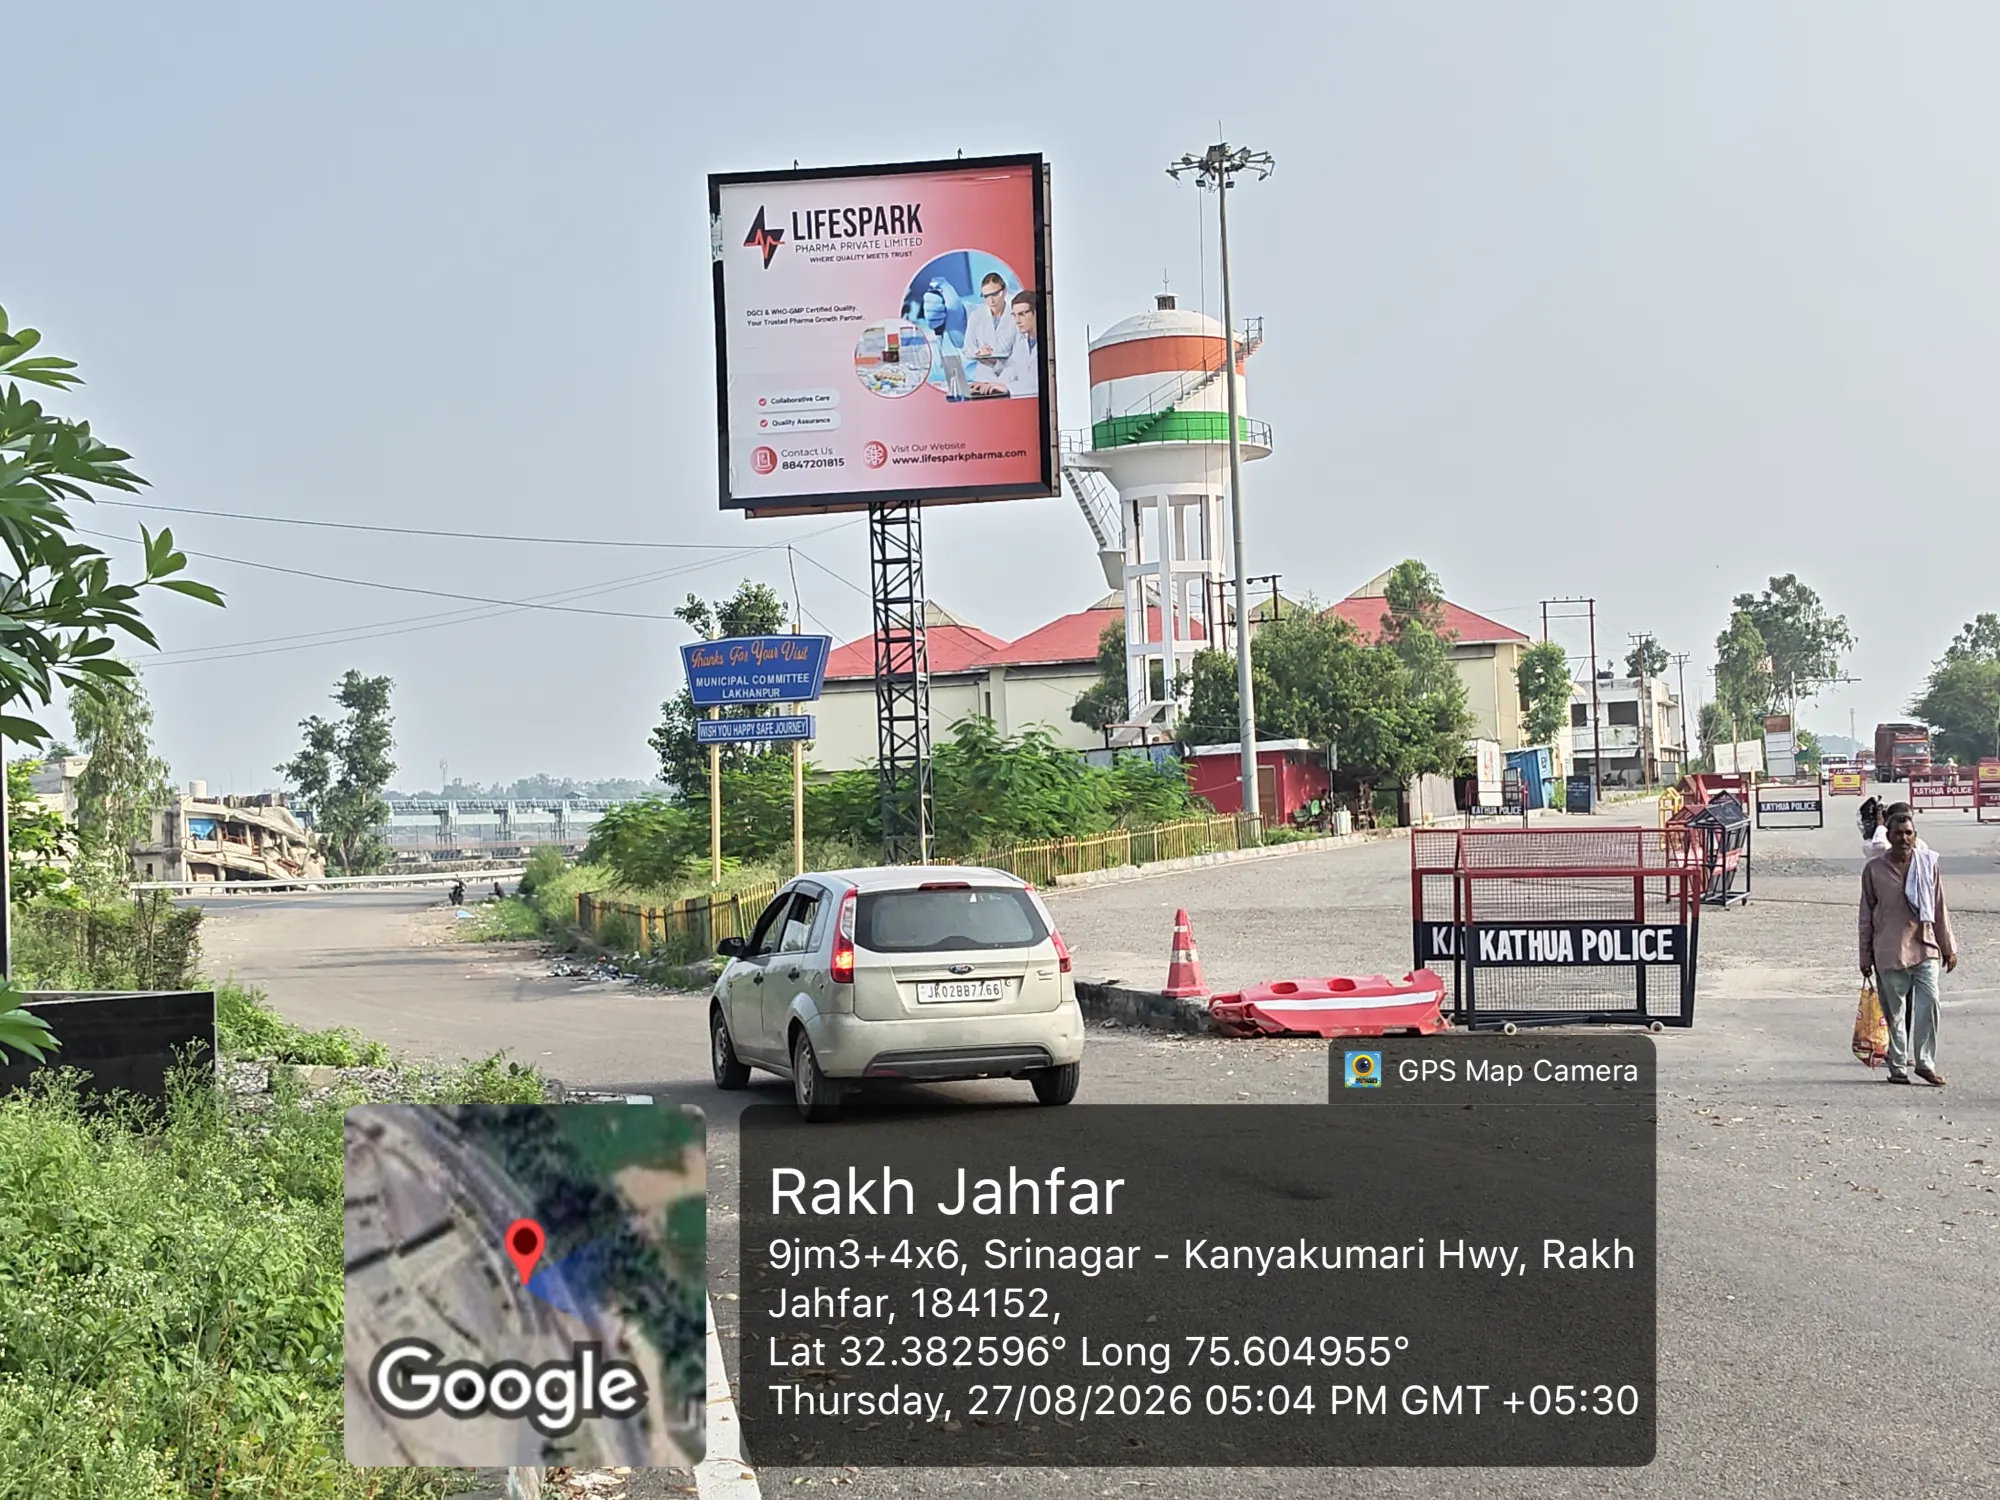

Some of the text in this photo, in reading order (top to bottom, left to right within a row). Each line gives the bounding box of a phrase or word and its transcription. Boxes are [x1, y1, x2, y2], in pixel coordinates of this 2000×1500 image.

[792, 203, 923, 241] LIFESPARK
[795, 237, 923, 254] PHARMA PRIVATE LIMITED
[810, 250, 913, 264] WHERE QUALITY MEETS TRUST
[771, 307, 804, 316] WHO-GMP
[805, 306, 832, 314] Certified
[764, 318, 788, 326] Trusted
[789, 317, 814, 325] Pharma
[815, 315, 838, 324] Growth
[770, 396, 813, 405] Collaborative
[772, 417, 831, 427] Quality Assurance
[781, 446, 833, 458] Contact Us
[891, 442, 966, 453] Visit Our Website
[892, 449, 1027, 465] www.lifesparkpharma.com
[782, 458, 845, 470] 8847201815
[692, 640, 809, 669] Thanks For Your Visit
[696, 673, 810, 687] MUNICIPAL COMMITTEE
[722, 688, 781, 699] LAKHANPUR
[700, 720, 806, 738] WISH YOU HAPPY SAFE JOURNEY
[1913, 786, 1973, 795] KATHUA POLICE
[1471, 805, 1522, 815] KATHUA POLICE
[1761, 801, 1817, 811] KATHUA POLICE
[1479, 928, 1674, 962] KATHUA POLICE
